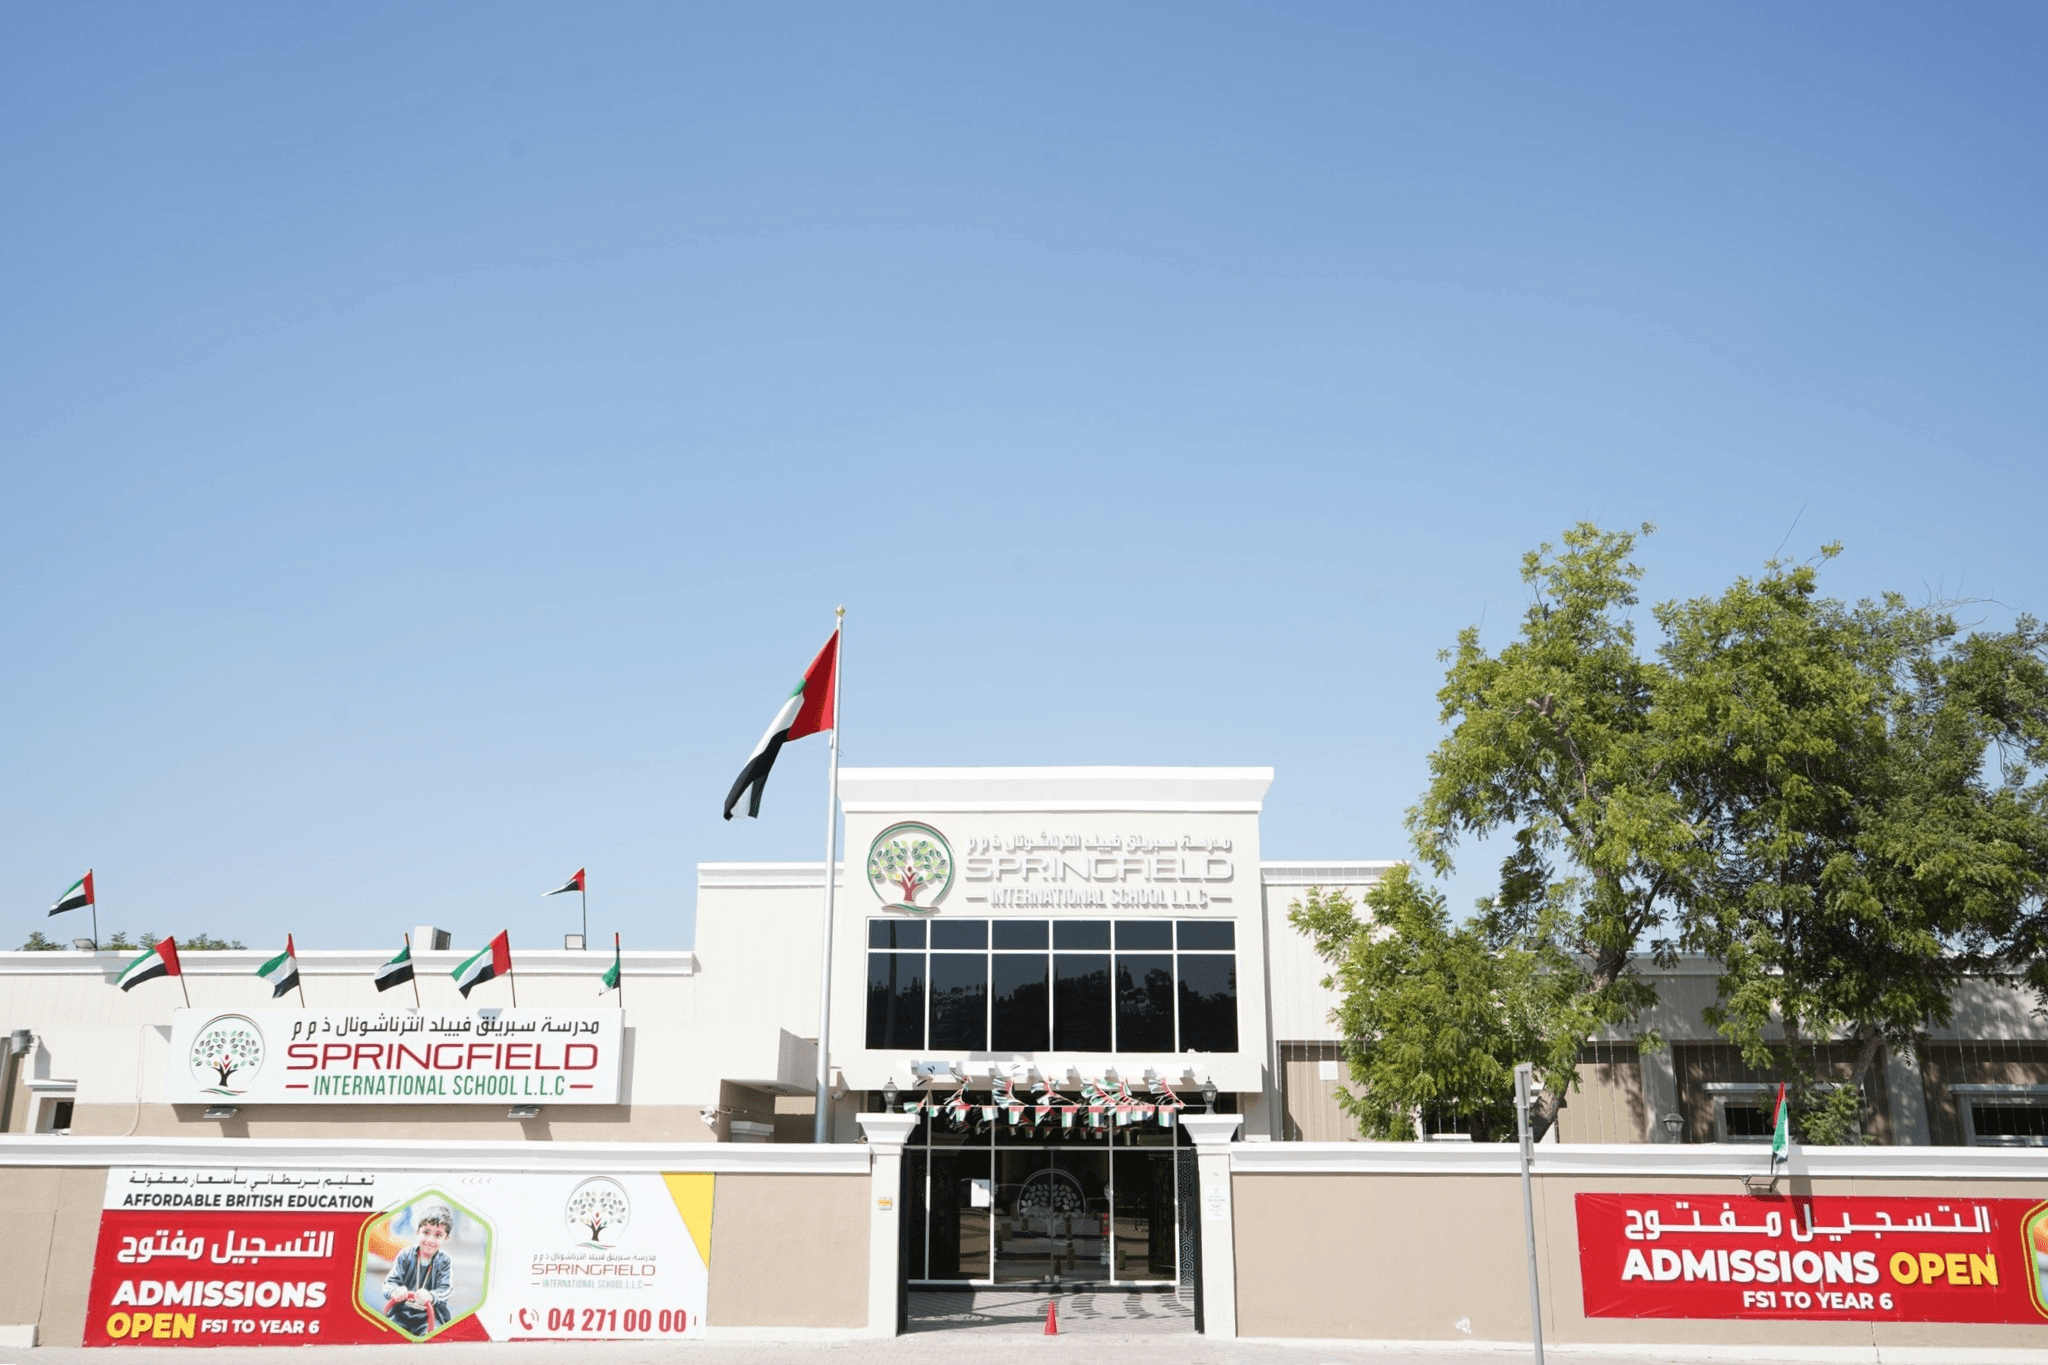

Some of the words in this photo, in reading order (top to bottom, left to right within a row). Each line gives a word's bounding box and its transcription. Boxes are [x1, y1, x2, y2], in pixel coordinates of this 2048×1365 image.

[965, 855, 1234, 882] SPRINGFIELD
[991, 886, 1107, 909] INTERNATIONAL
[1111, 886, 1168, 909] SCHOOL
[291, 1020, 303, 1041] م
[305, 1020, 317, 1041] م
[321, 1016, 331, 1033] ذ
[336, 1013, 424, 1037] انترناشونال
[476, 1016, 536, 1037] سبرينق
[541, 1016, 600, 1037] مدرسة
[286, 1043, 599, 1070] SPRINGFIELD
[313, 1075, 447, 1096] INTERNATIONAL
[453, 1075, 518, 1096] SCHOOL
[524, 1075, 565, 1096] L.L.C
[129, 1170, 189, 1188] معقولة
[250, 1173, 321, 1192] بريطاني
[323, 1174, 375, 1190] تعليم
[122, 1193, 222, 1207] AFFORDABLE
[226, 1194, 283, 1208] BRITISH
[287, 1194, 374, 1208] EDUCATION
[1624, 1201, 1782, 1241] مفتوح
[1791, 1202, 1992, 1243] التسجيل
[116, 1229, 205, 1264] مفتوح
[211, 1230, 335, 1265] التسجيل
[531, 1263, 656, 1276] SPRINGFIELD
[1621, 1249, 1879, 1285] ADMISSIONS
[1889, 1251, 1999, 1286] OPEN
[111, 1280, 327, 1308] ADMISSIONS
[542, 1280, 595, 1288] INTERNATIONAL
[598, 1280, 624, 1289] SCHOOL
[1743, 1291, 1777, 1309] FS1
[1782, 1291, 1811, 1309] TO
[1815, 1292, 1875, 1309] YEAR
[1879, 1292, 1893, 1310] 6
[106, 1312, 197, 1339] OPEN
[201, 1319, 228, 1334] FS1
[232, 1319, 255, 1334] TO
[260, 1319, 304, 1334] YEAR
[308, 1319, 320, 1334] 6
[548, 1307, 575, 1331] 04
[581, 1308, 617, 1332] 271
[623, 1308, 652, 1333] 00
[658, 1309, 687, 1333] 00
